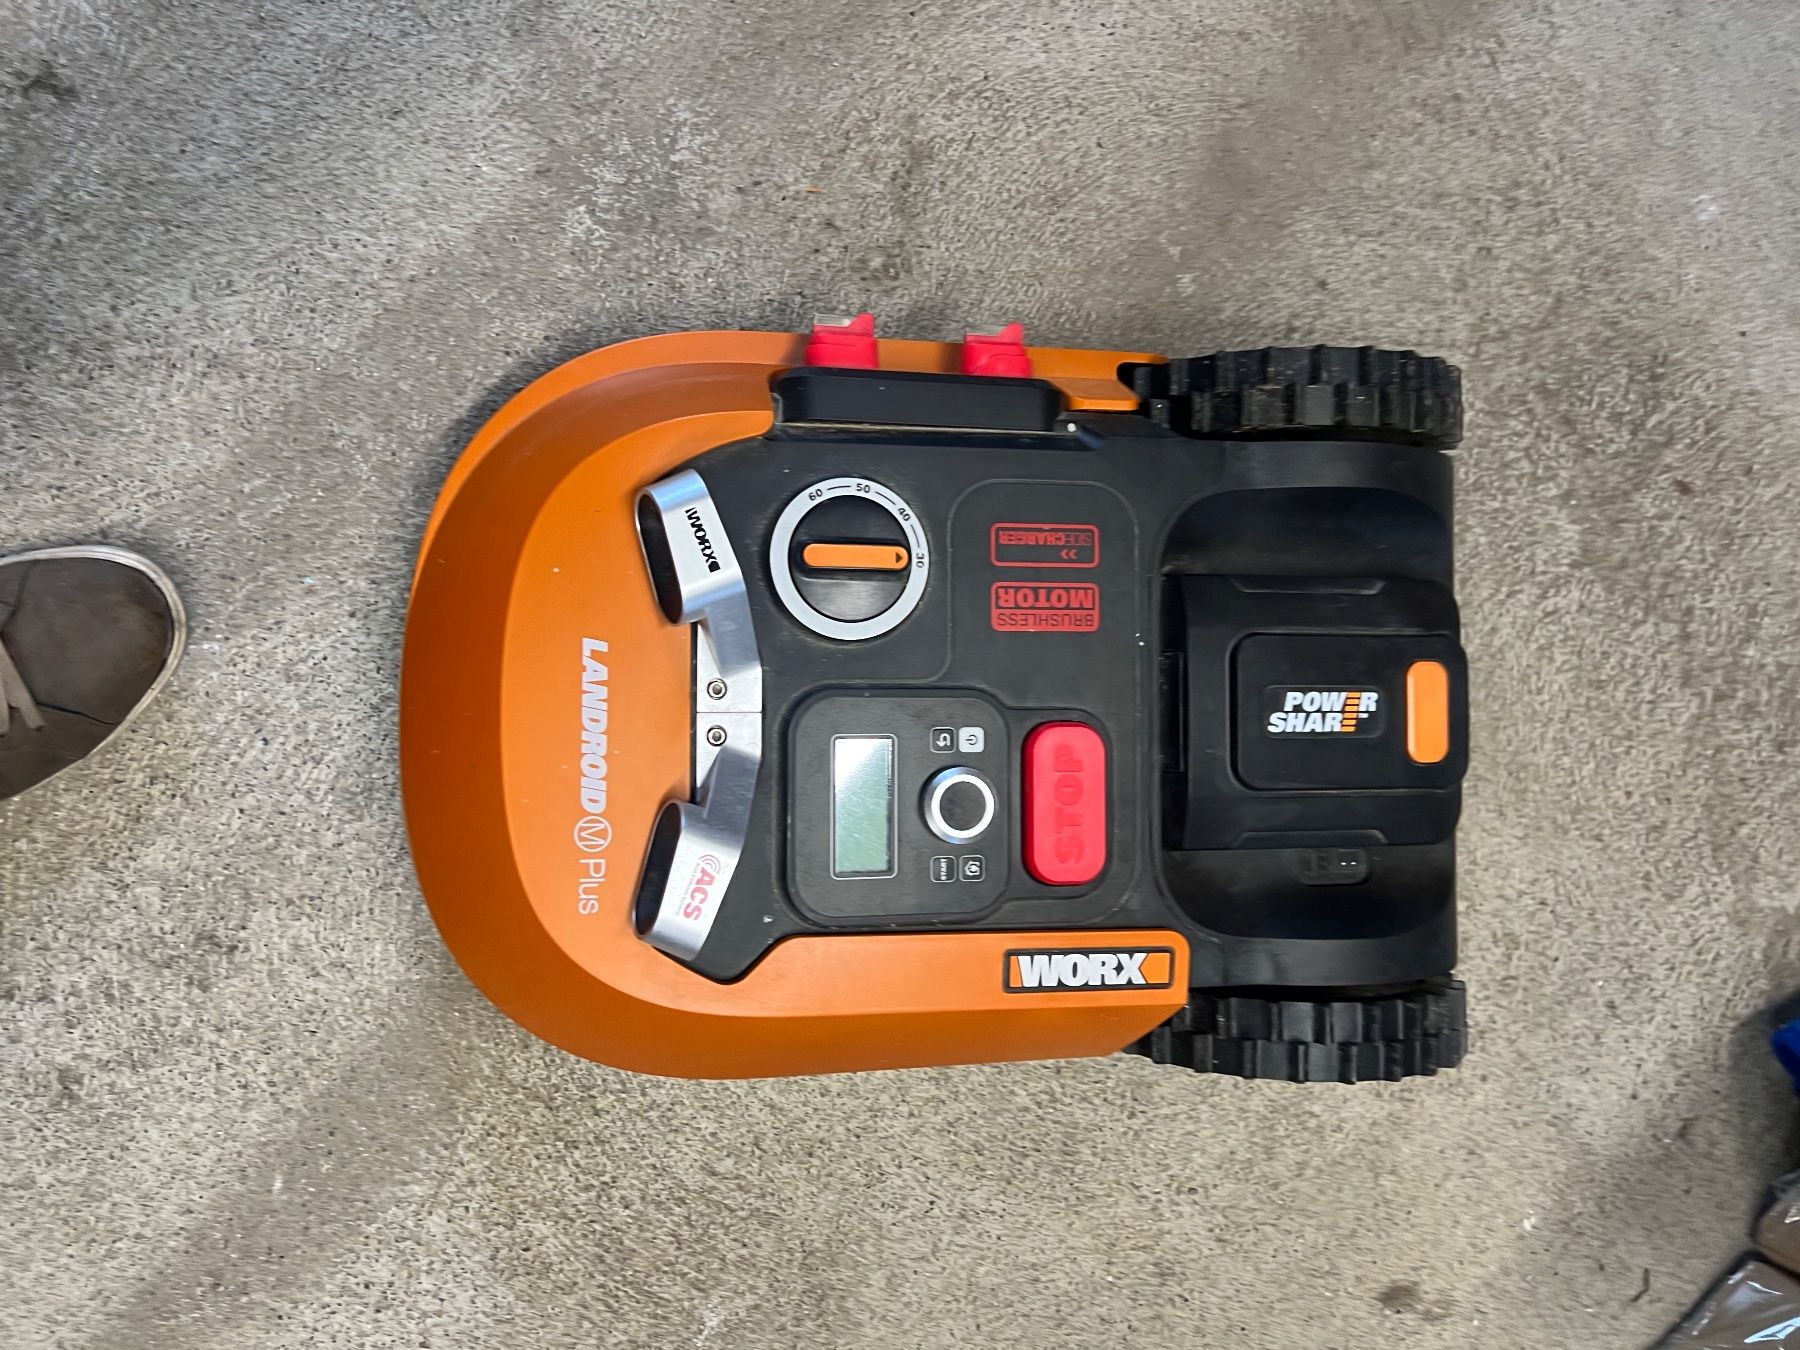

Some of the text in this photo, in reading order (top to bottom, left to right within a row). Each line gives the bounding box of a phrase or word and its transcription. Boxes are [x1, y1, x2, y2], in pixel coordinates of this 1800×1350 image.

[808, 488, 823, 501] 60
[855, 482, 871, 494] 50
[897, 506, 911, 522] 40
[686, 510, 718, 564] WORX
[916, 552, 925, 569] 30
[997, 587, 1094, 609] MOTOR
[997, 612, 1094, 627] BRUSHLESS
[1283, 691, 1379, 712] POWER
[577, 637, 608, 915] LANDROID M Plus
[1054, 743, 1085, 864] STOP
[683, 866, 716, 921] ACS
[1017, 952, 1148, 988] WORX
